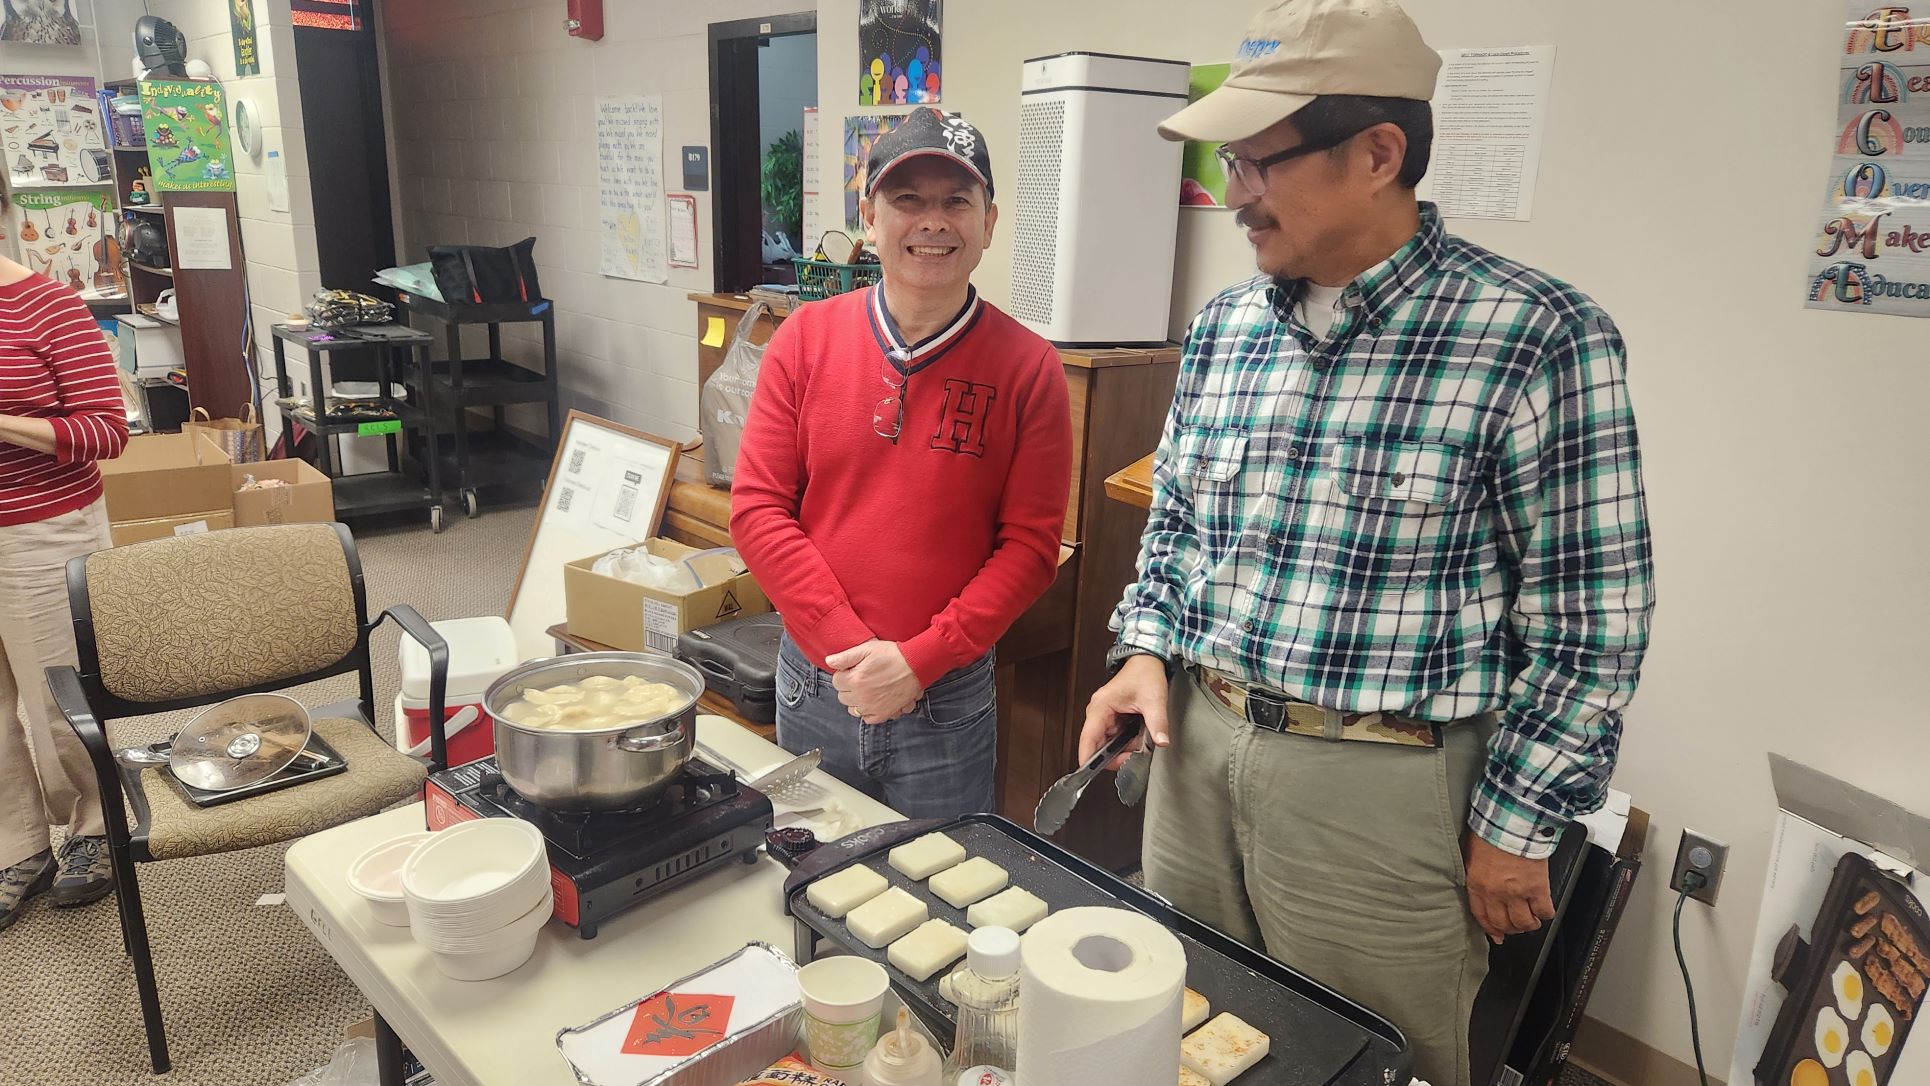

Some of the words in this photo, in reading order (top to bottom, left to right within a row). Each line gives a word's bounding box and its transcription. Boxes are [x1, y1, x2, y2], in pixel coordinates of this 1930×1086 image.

[140, 81, 221, 103] Individuality
[20, 194, 62, 207] String
[931, 378, 997, 459] H
